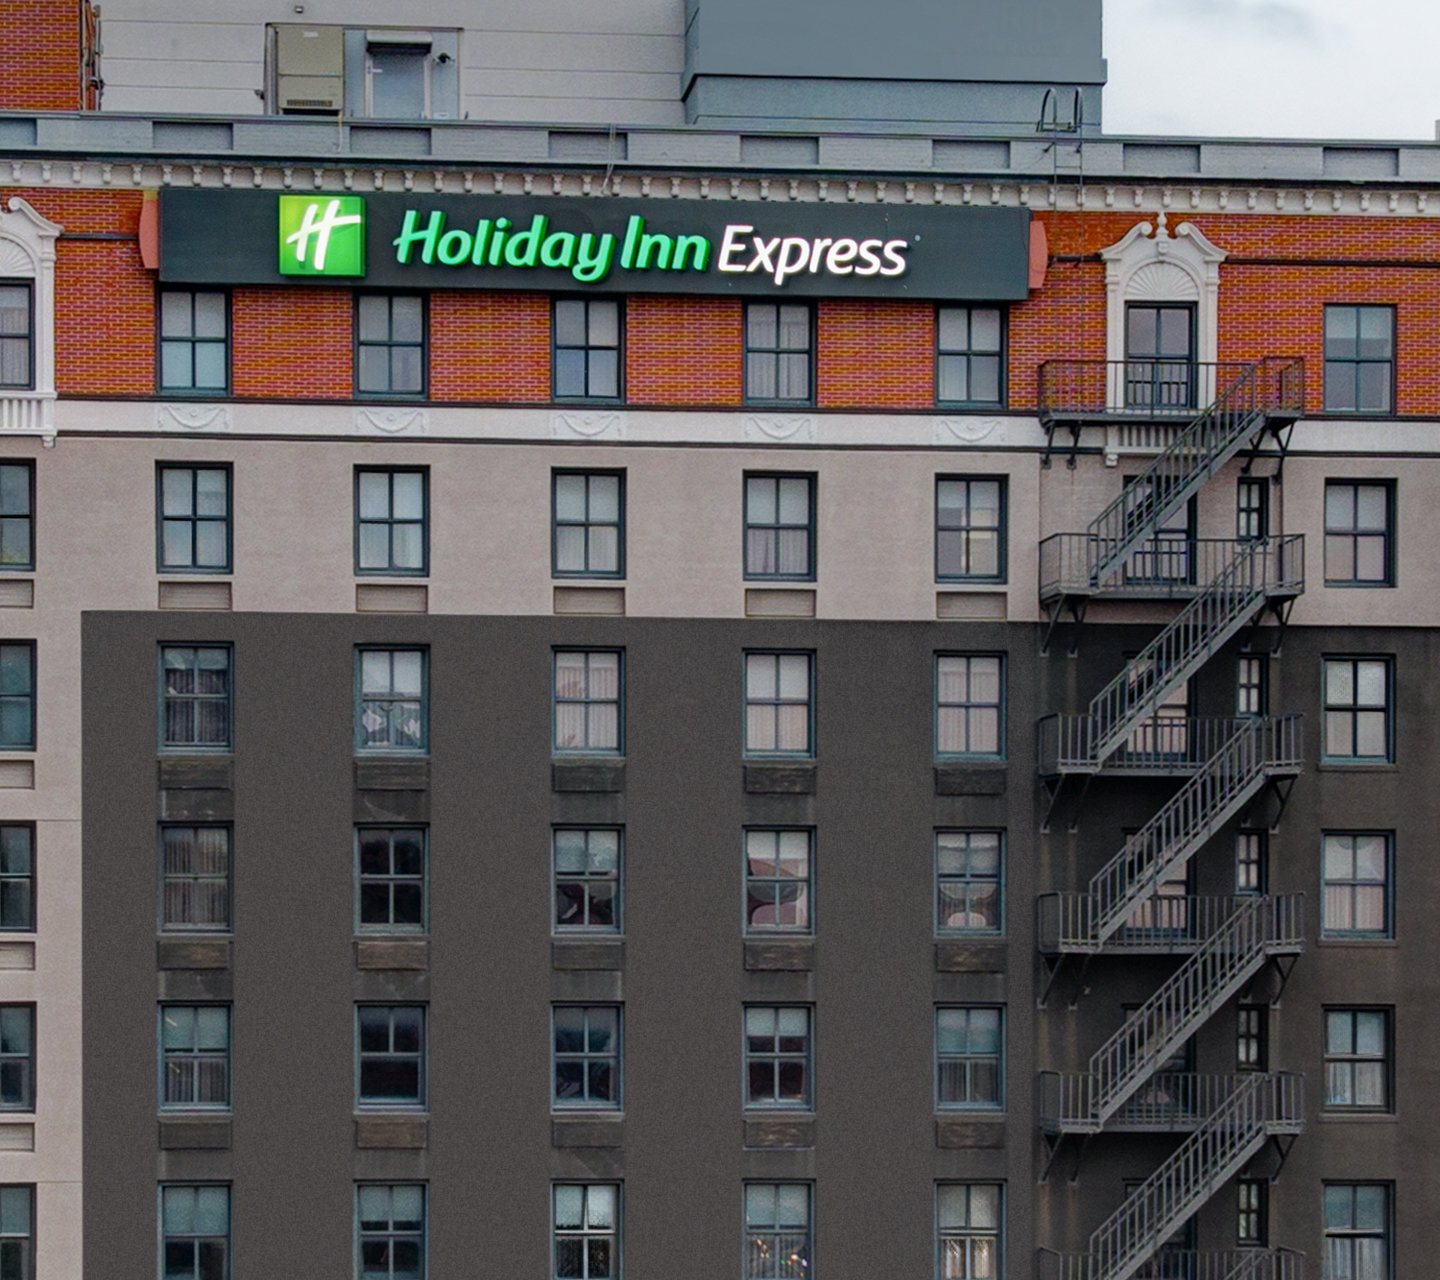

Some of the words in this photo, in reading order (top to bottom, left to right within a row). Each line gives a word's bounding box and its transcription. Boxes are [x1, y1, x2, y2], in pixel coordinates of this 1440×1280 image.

[392, 210, 617, 282] Holiday
[620, 214, 710, 271] Inn
[718, 224, 908, 286] Express
